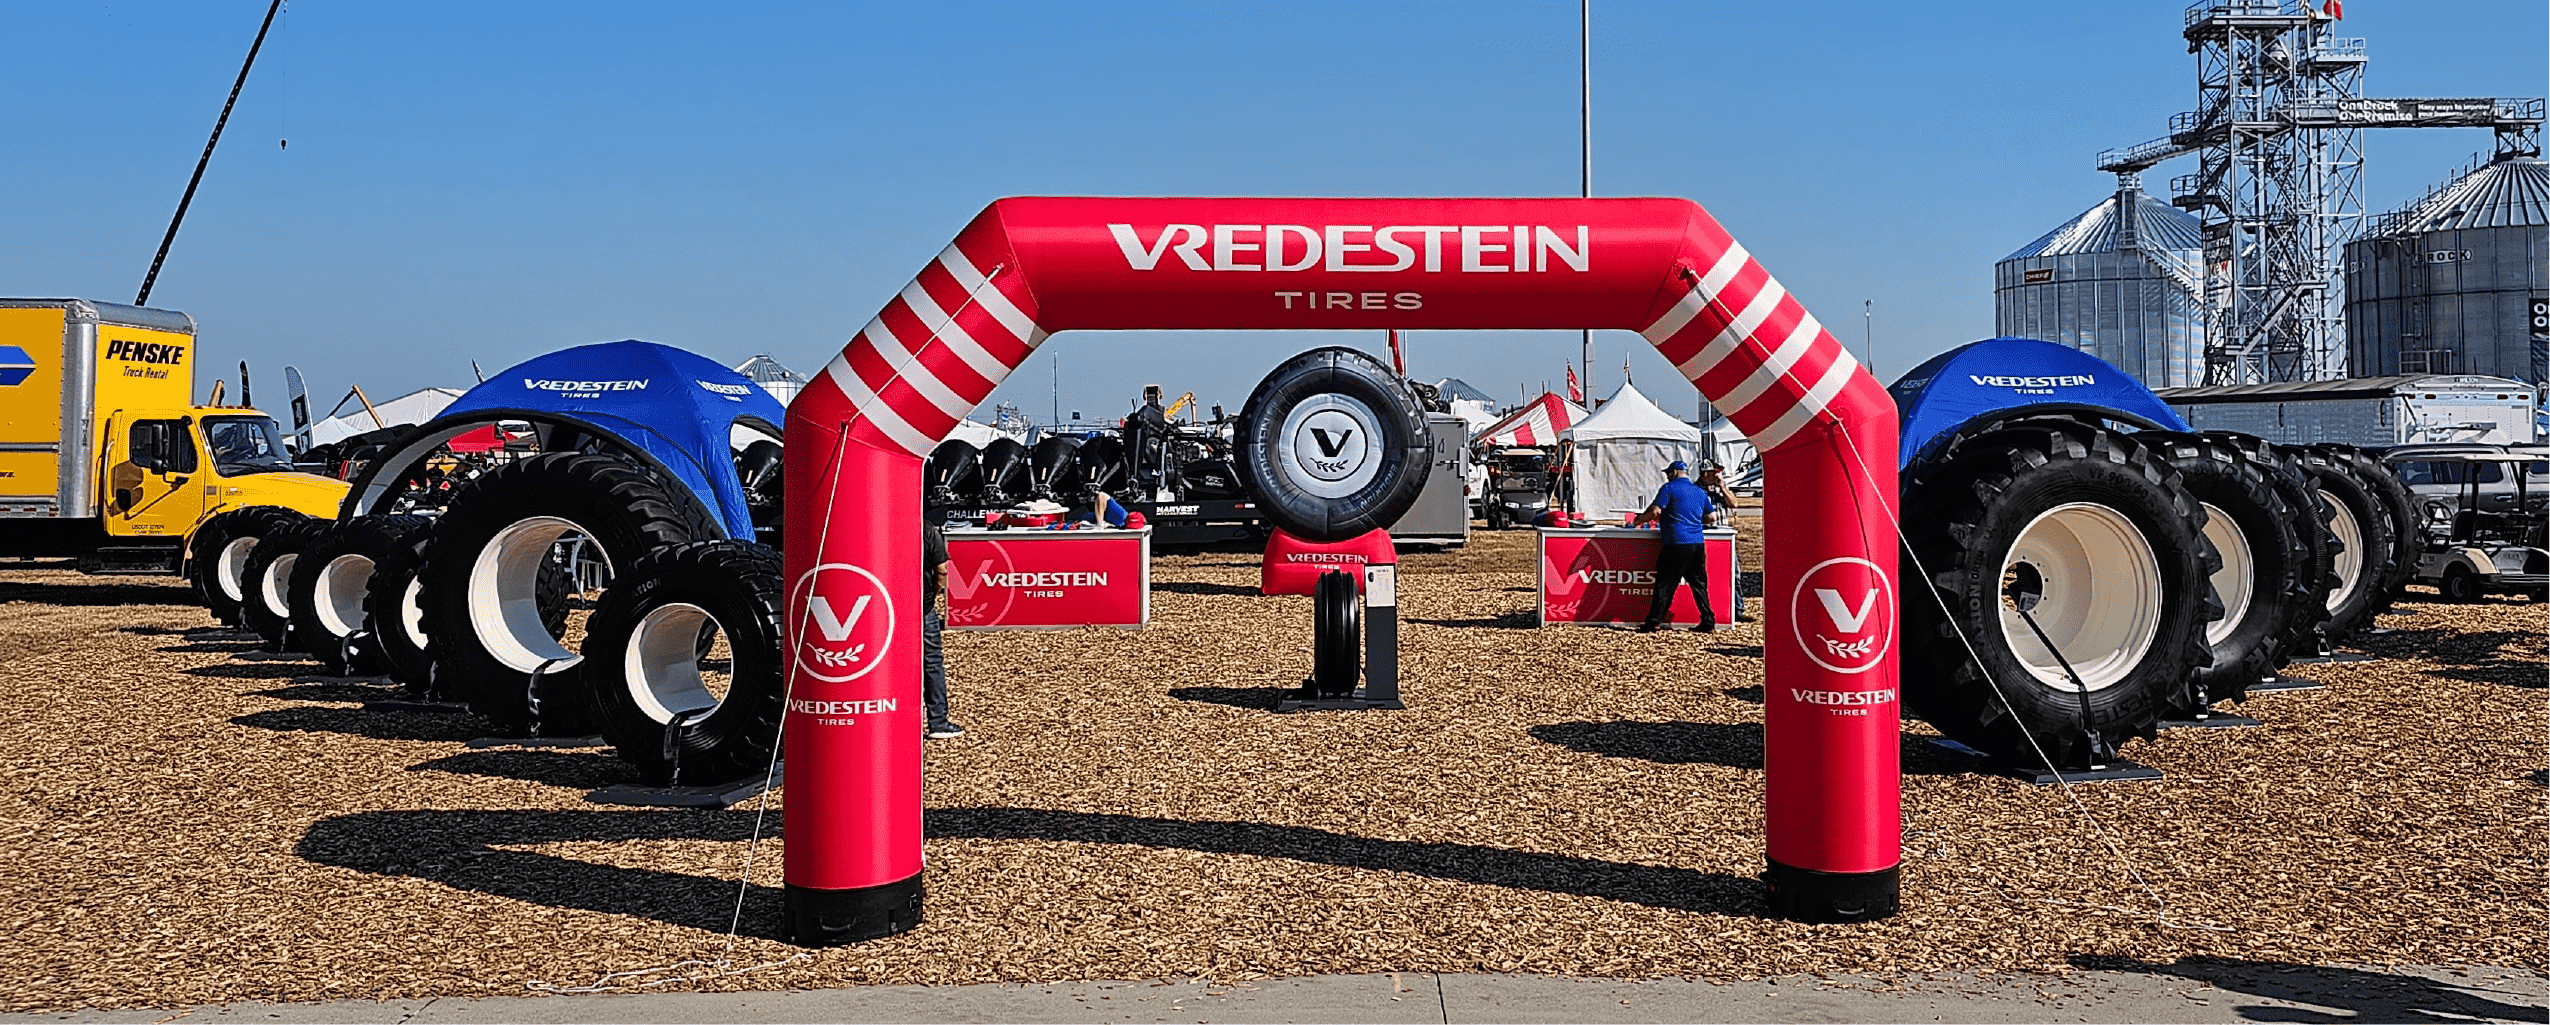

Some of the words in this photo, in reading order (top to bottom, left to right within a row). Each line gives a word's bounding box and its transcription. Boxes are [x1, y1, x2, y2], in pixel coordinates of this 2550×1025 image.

[1107, 223, 1589, 272] VREDESTEIN
[2417, 250, 2467, 263] BROCK
[1274, 291, 1424, 309] TIRES
[105, 339, 186, 366] PENSKE
[123, 365, 143, 378] Truck
[145, 367, 169, 379] Rental
[524, 378, 649, 391] VREDESTEIN
[1969, 374, 2096, 387] VREDESTEIN
[946, 509, 1007, 519] CHALLE
[1156, 505, 1200, 513] HARVEST
[1286, 553, 1369, 563] VREDESTEIN
[981, 571, 1108, 587] VREDESTEIN
[1578, 569, 1658, 584] VREDES
[1024, 590, 1064, 598] TIRES
[1790, 687, 1896, 706] VREDESTEIN
[789, 698, 897, 715] VREDESTEIN
[1829, 708, 1868, 716] TIRES
[817, 718, 856, 726] TIRES
